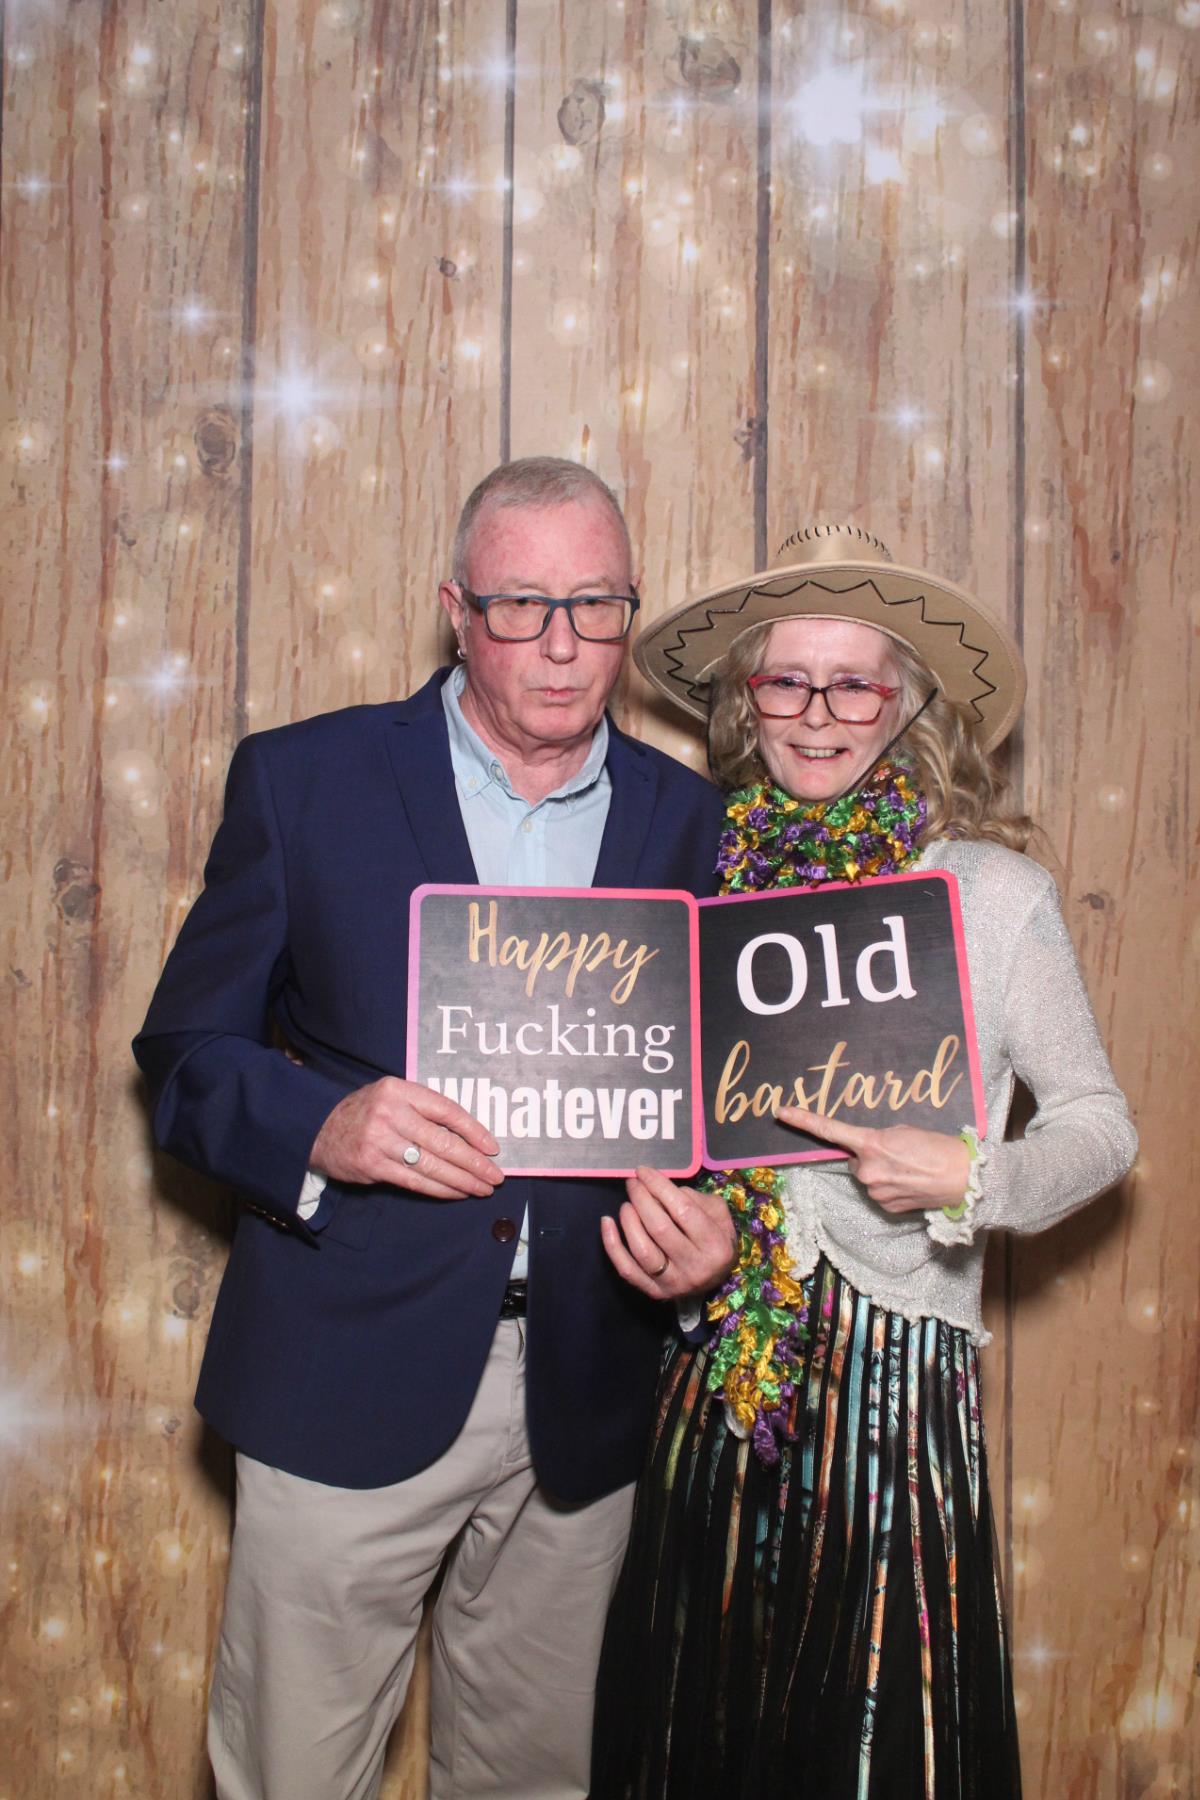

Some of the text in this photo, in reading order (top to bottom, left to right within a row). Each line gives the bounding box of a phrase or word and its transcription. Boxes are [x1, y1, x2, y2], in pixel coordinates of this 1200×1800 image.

[468, 900, 660, 1005] Happy
[736, 915, 917, 1016] Old
[436, 1004, 676, 1074] Fucking
[714, 1034, 964, 1124] bastard
